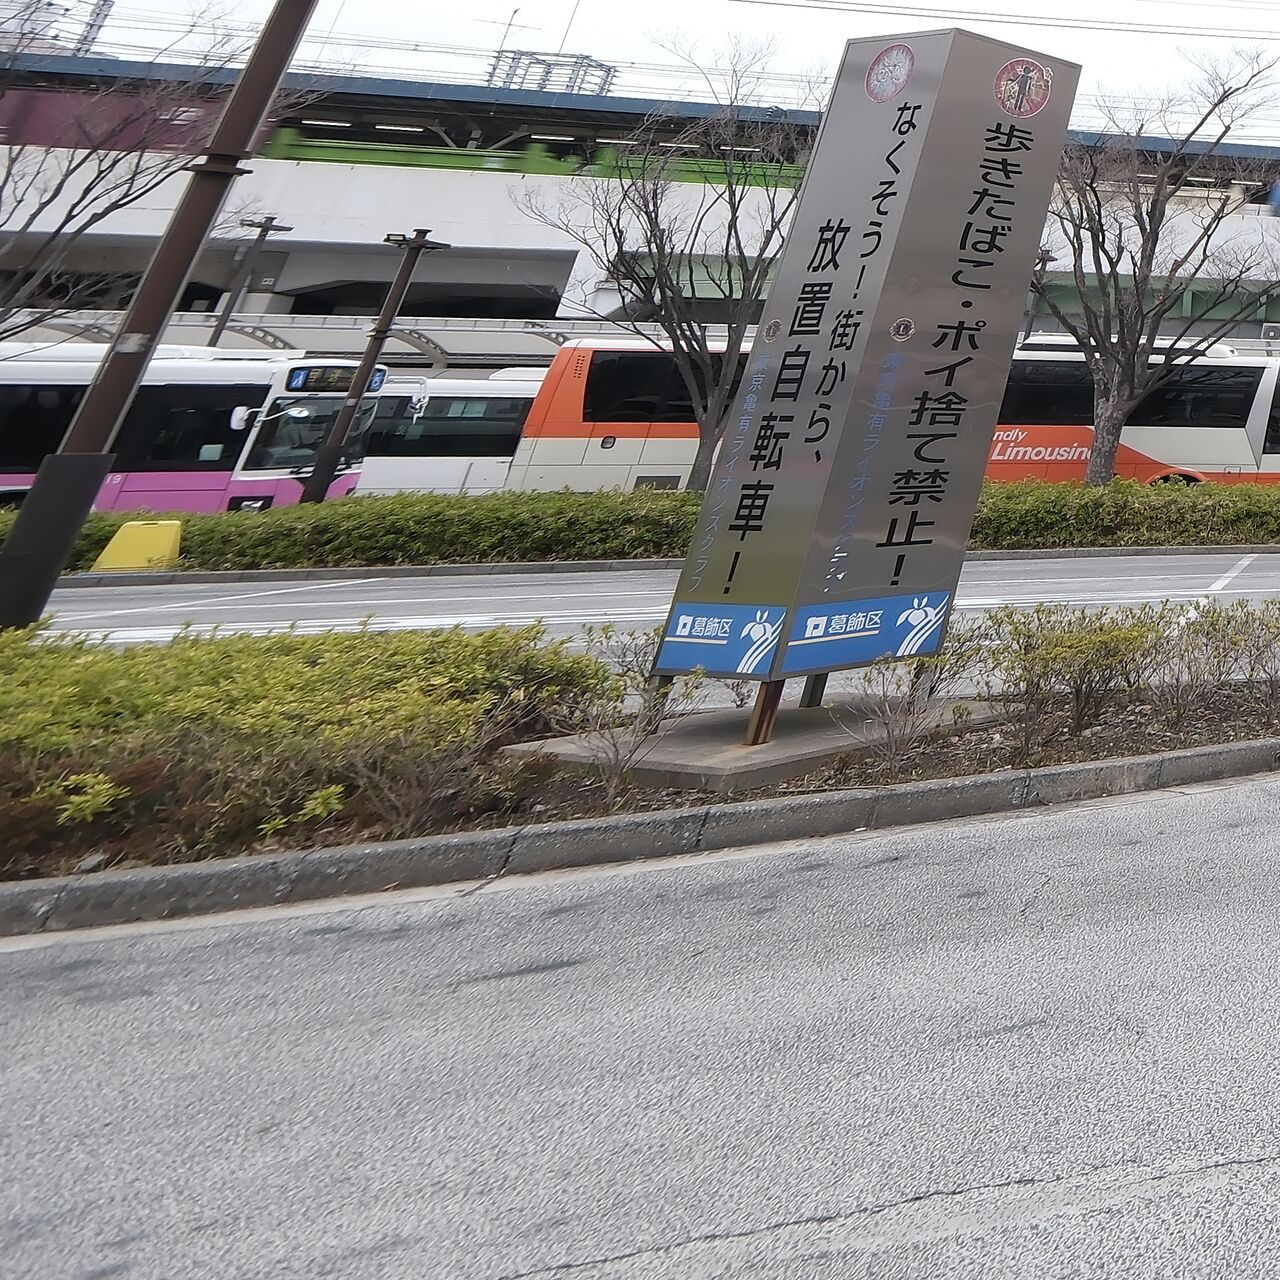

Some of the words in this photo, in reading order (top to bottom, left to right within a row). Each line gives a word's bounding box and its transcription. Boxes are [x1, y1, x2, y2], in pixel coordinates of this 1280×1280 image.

[992, 428, 1028, 442] ndly
[690, 616, 734, 638] 葛飾区
[827, 610, 884, 635] 葛飾区
